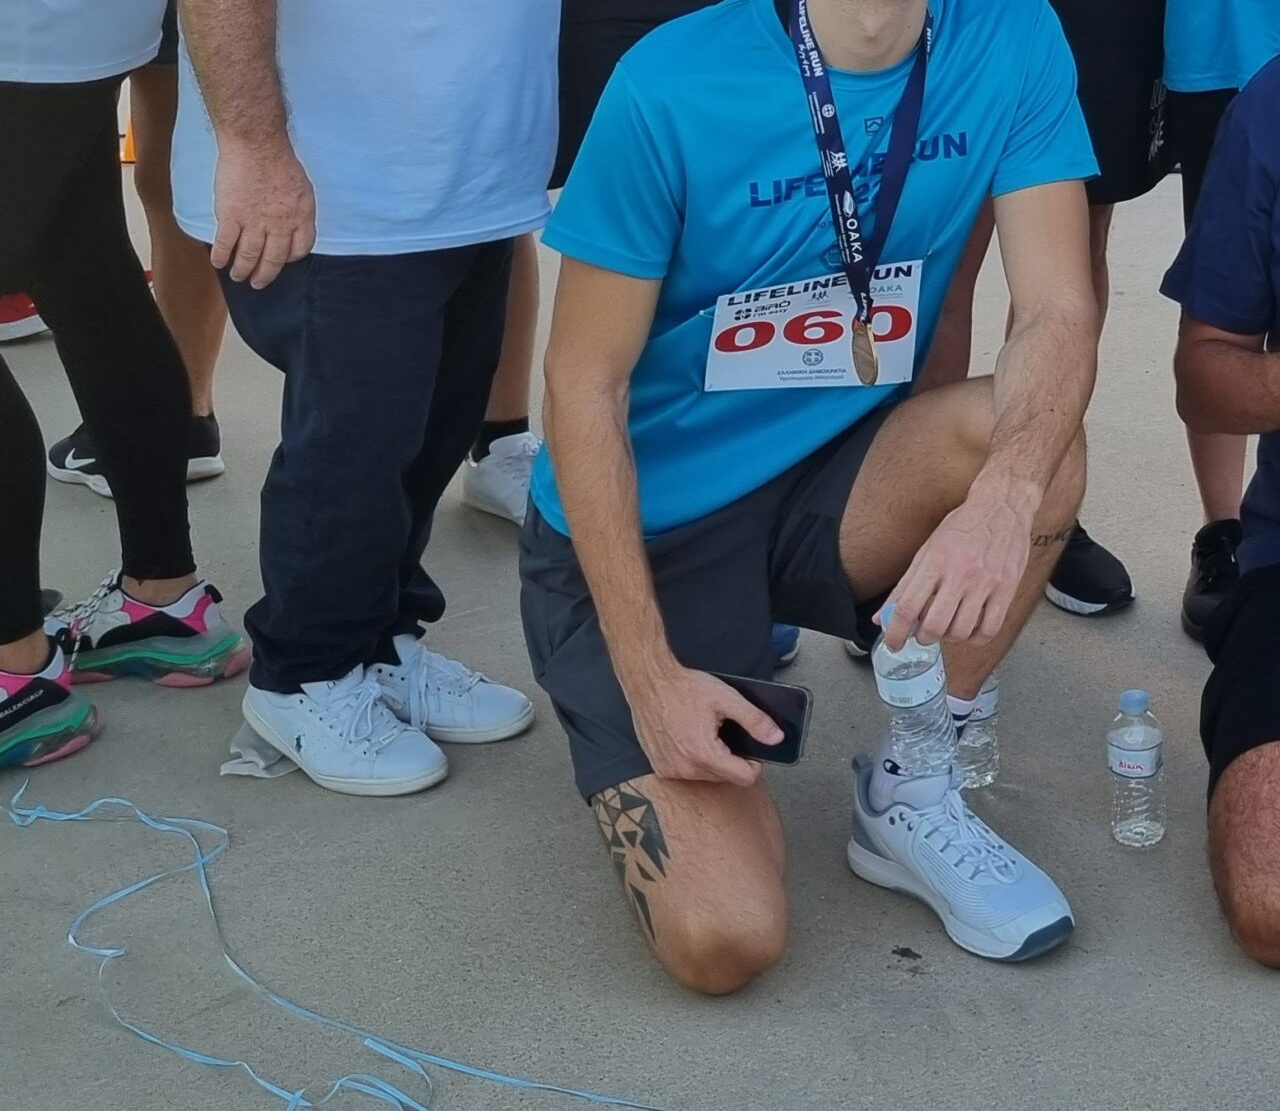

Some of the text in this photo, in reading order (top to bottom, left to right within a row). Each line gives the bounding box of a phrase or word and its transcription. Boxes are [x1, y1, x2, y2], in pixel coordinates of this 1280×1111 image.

[799, 0, 815, 51] LIFELINE
[809, 50, 824, 77] RUN
[908, 132, 967, 163] UN
[847, 218, 864, 263] OAKA
[727, 275, 847, 307] LIFELINE
[874, 265, 912, 280] UN
[715, 305, 912, 353] 060
